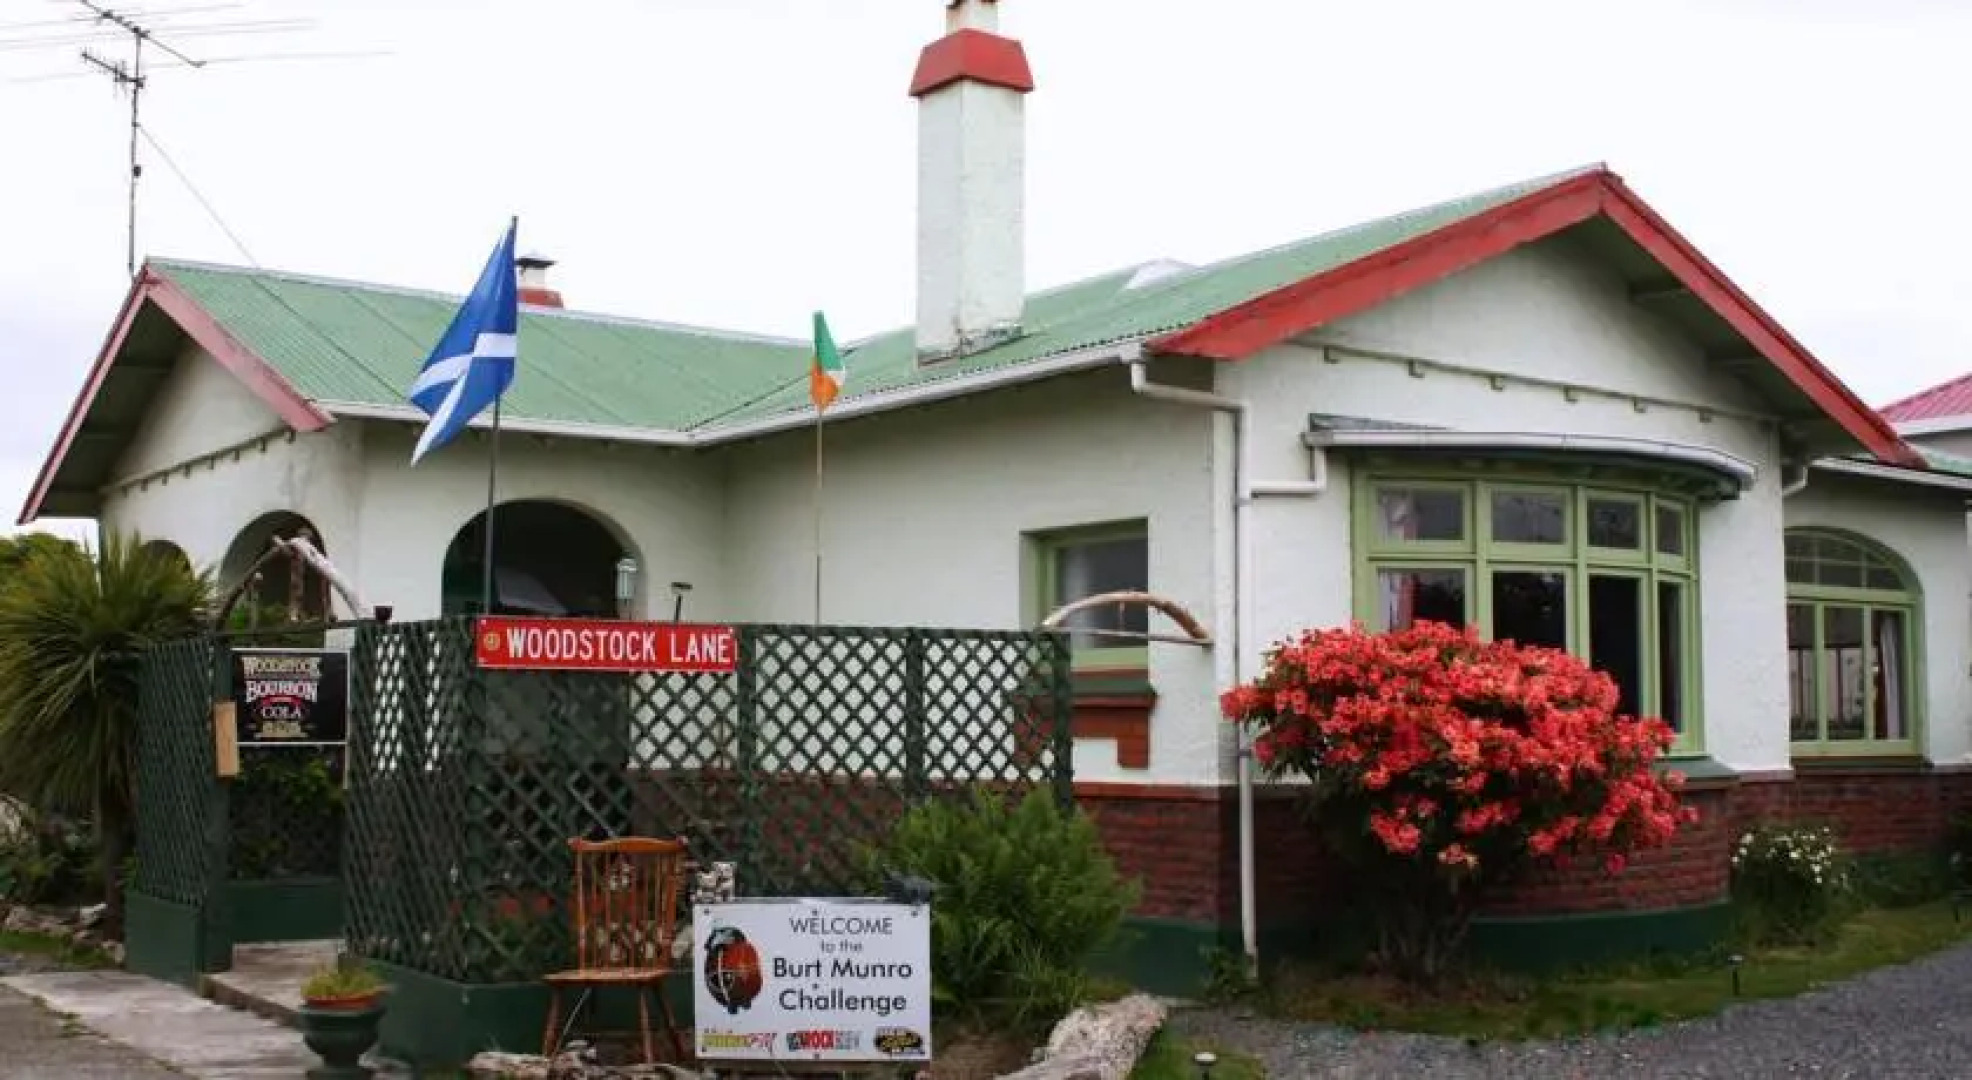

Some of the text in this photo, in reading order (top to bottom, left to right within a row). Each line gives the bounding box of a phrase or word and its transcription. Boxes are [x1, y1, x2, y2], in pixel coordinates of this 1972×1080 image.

[506, 627, 731, 664] WOODSTOCK LANE
[789, 917, 893, 935] WELCOME
[820, 939, 863, 953] to the
[773, 957, 914, 979] Burt Munro
[778, 988, 907, 1017] Challenge
